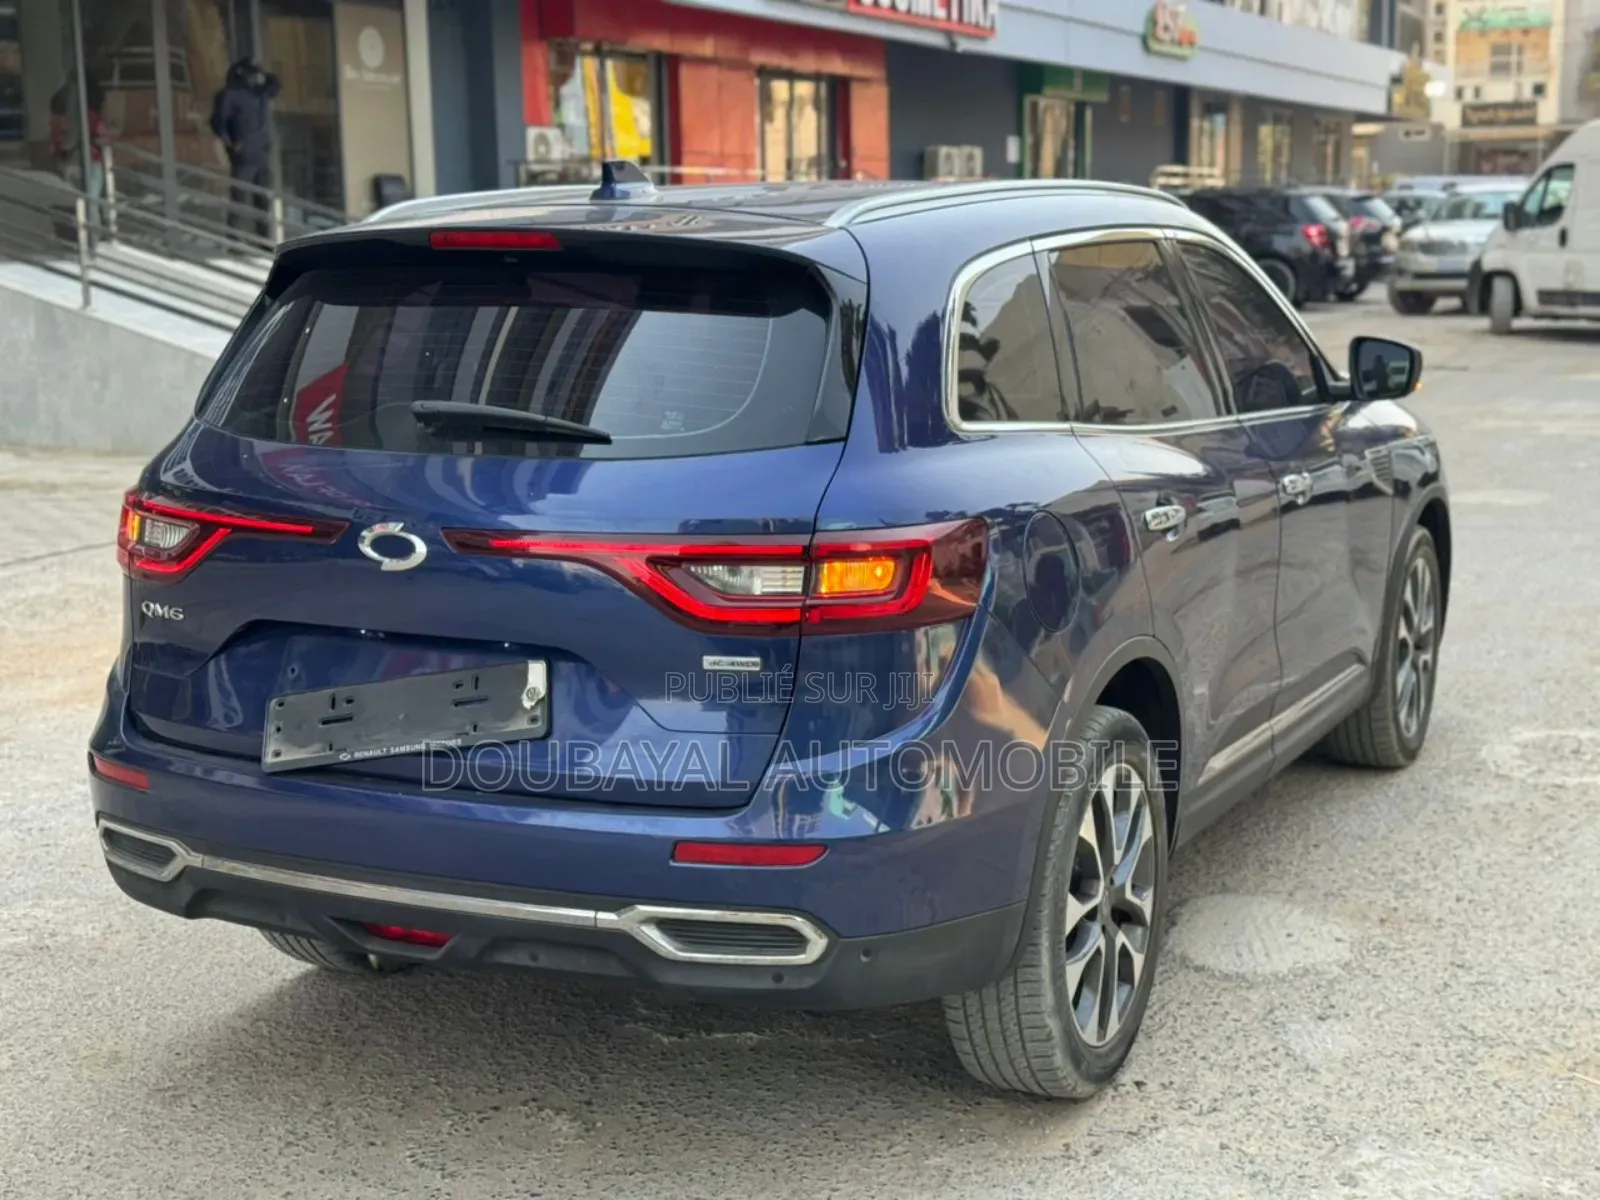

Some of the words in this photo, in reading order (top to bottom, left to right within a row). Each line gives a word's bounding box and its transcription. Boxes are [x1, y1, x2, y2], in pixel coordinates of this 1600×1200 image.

[141, 600, 184, 620] QM6
[353, 747, 388, 759] RENAULT
[389, 742, 426, 755] SAMSUNG
